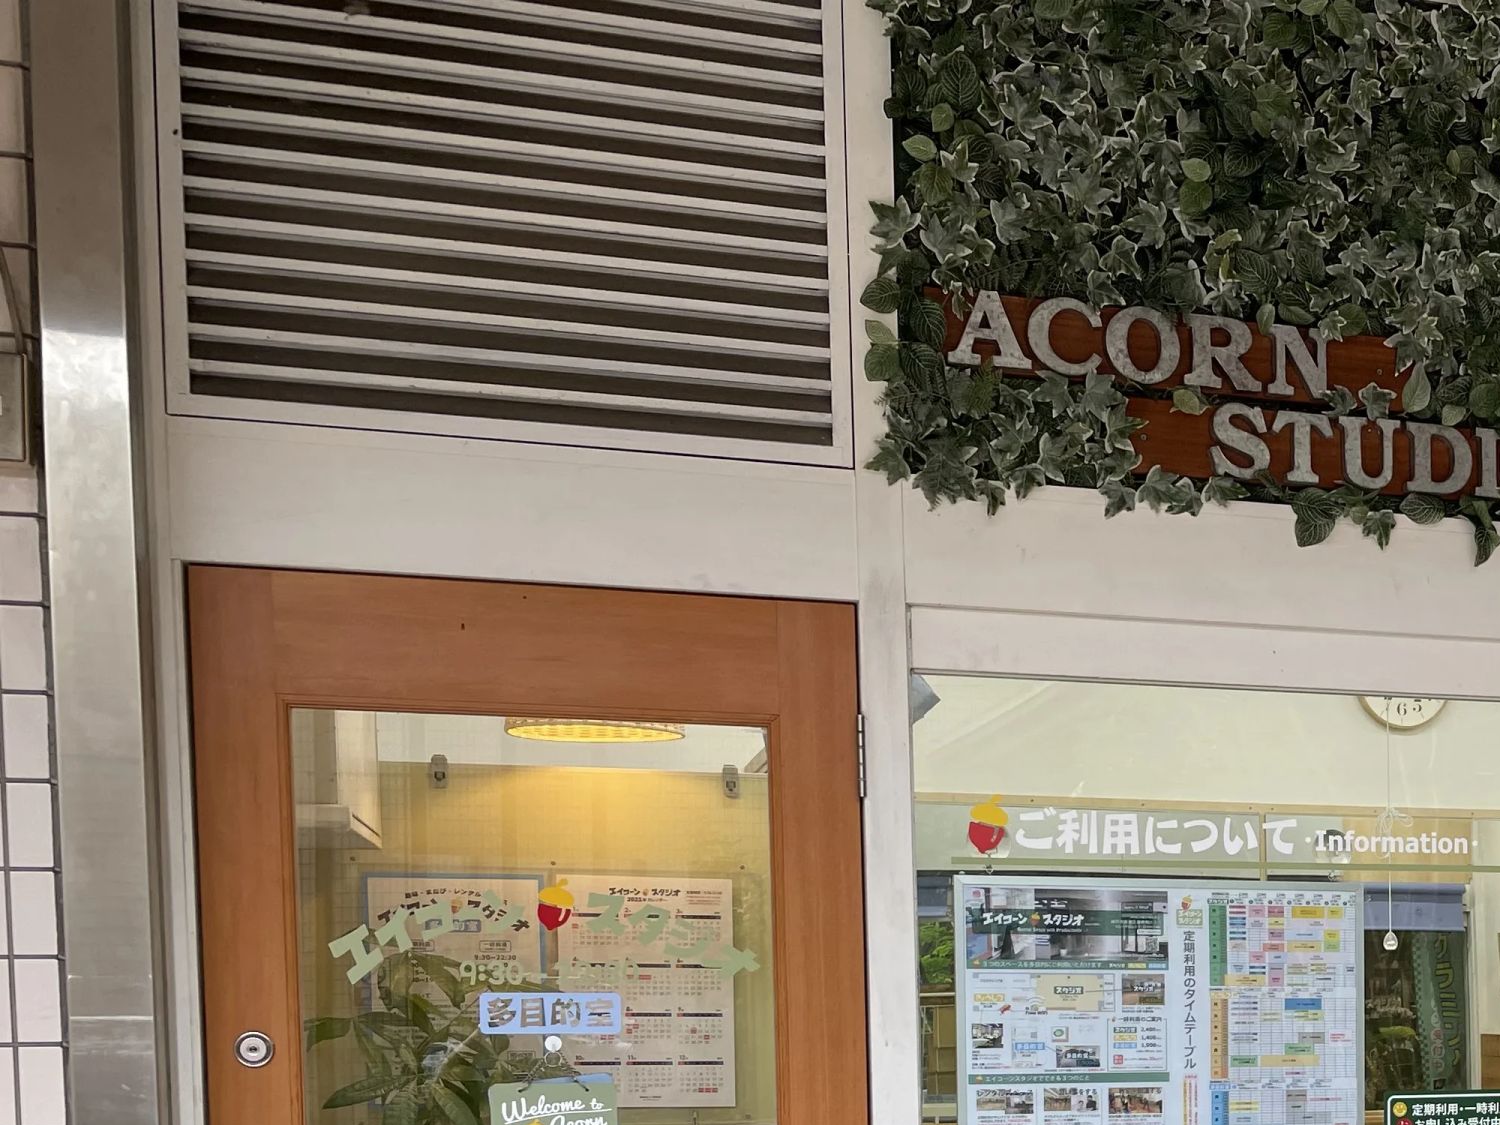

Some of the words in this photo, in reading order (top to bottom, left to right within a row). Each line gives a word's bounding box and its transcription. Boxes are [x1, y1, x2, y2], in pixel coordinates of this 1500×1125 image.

[947, 290, 1337, 399] ACORN
[1014, 806, 1298, 857] ご利用について
[327, 888, 526, 985] エイコーン
[586, 891, 761, 981] スタジオ
[982, 912, 1028, 926] エイコーン
[1042, 912, 1086, 926] スタジオ
[487, 997, 614, 1028] 多目的室
[1183, 930, 1197, 1070] 定期利用のタイムテーブル
[501, 1094, 585, 1123] Welcome
[588, 1097, 604, 1110] to
